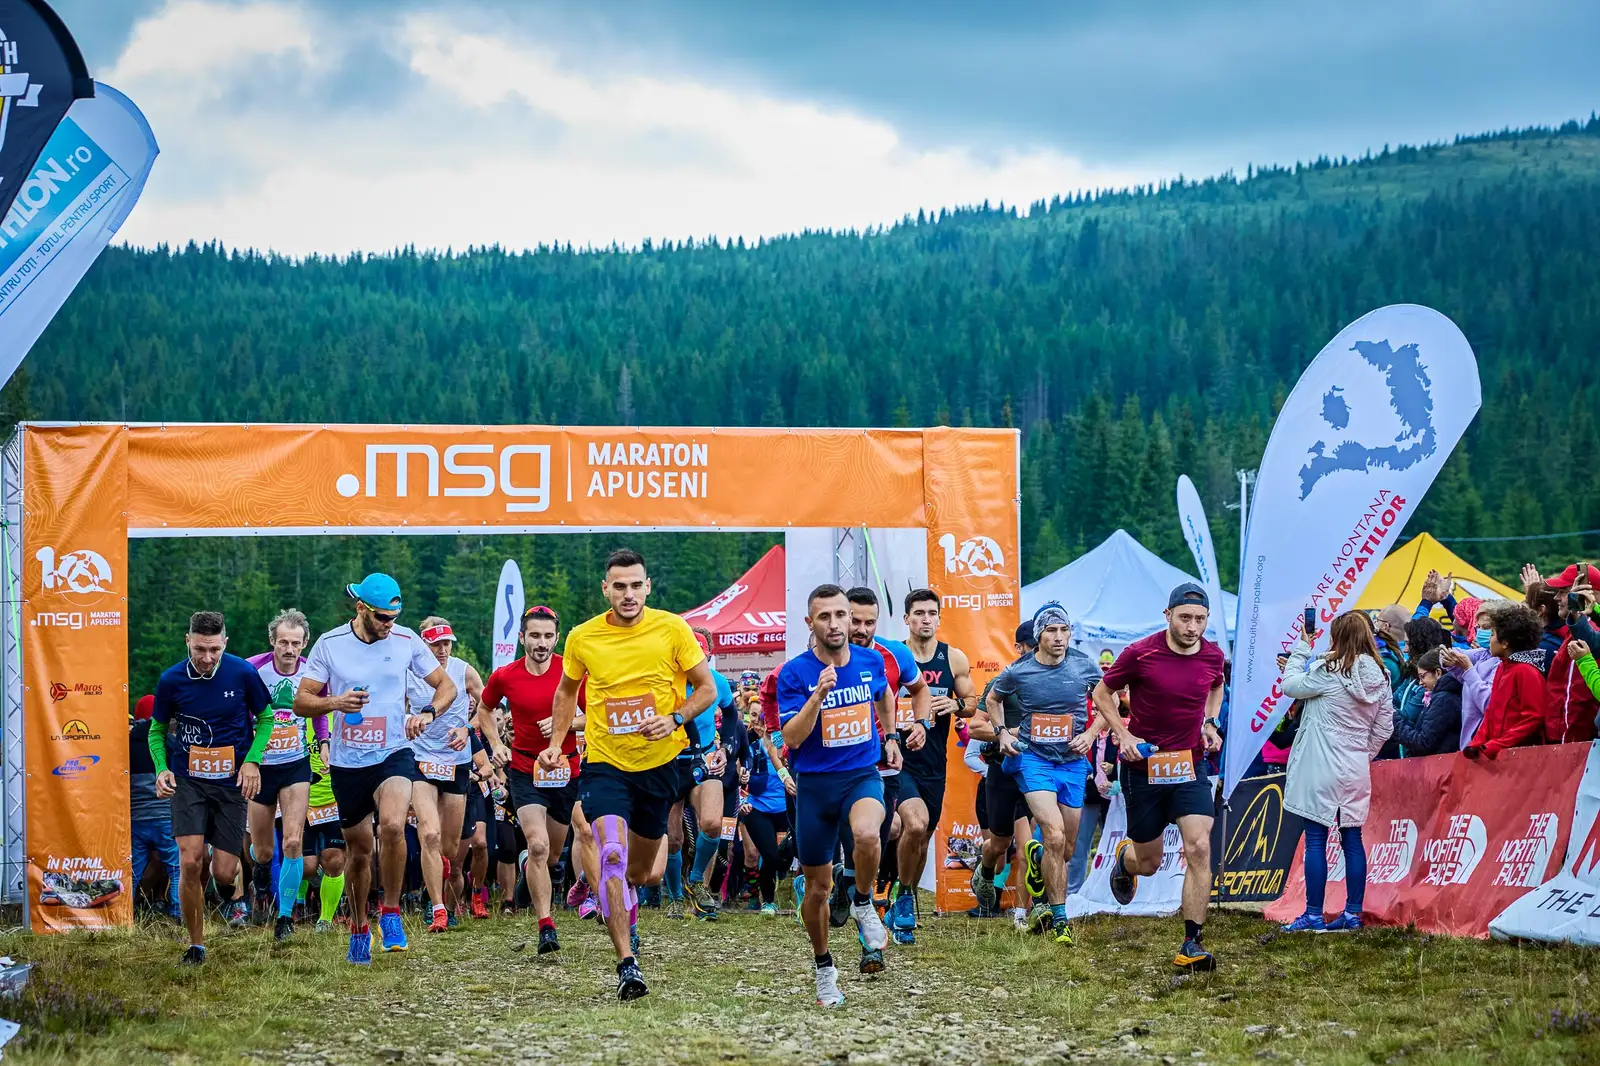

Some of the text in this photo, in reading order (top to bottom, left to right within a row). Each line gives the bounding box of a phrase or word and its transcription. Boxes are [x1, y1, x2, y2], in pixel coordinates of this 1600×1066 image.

[0, 146, 92, 249] HLON.ro
[0, 273, 21, 304] NTRU
[37, 231, 64, 257] TOTUL
[60, 199, 93, 234] PENTRU
[89, 175, 117, 204] SPORT
[587, 442, 708, 467] MARATON
[587, 471, 707, 499] APUSENI
[1321, 494, 1406, 623] CARPATILOR
[1281, 489, 1391, 652] ALERARE MONTANA
[90, 618, 120, 626] APUSENI
[719, 632, 786, 645] URSUS REGE
[74, 683, 102, 692] Maros
[923, 670, 943, 684] DY
[610, 706, 655, 726] 1416
[344, 727, 384, 743] 1248
[826, 717, 869, 739] 1201
[1034, 724, 1069, 737] 1451
[272, 735, 298, 750] 072
[192, 759, 233, 772] 1315
[422, 763, 453, 777] 1365
[537, 767, 570, 780] 1485
[1152, 761, 1192, 777] 1142
[1389, 819, 1408, 842] THE
[1447, 814, 1471, 838] THE
[1525, 813, 1550, 838] THE
[1366, 842, 1402, 865] NORTH
[1420, 839, 1463, 862] NORTH
[1496, 838, 1539, 862] NORTH
[47, 855, 103, 871] ÎN RITMUL
[1421, 862, 1456, 886] FACE
[1366, 865, 1397, 884] FACE
[1491, 862, 1528, 887] FACE
[1537, 889, 1595, 914] THE
